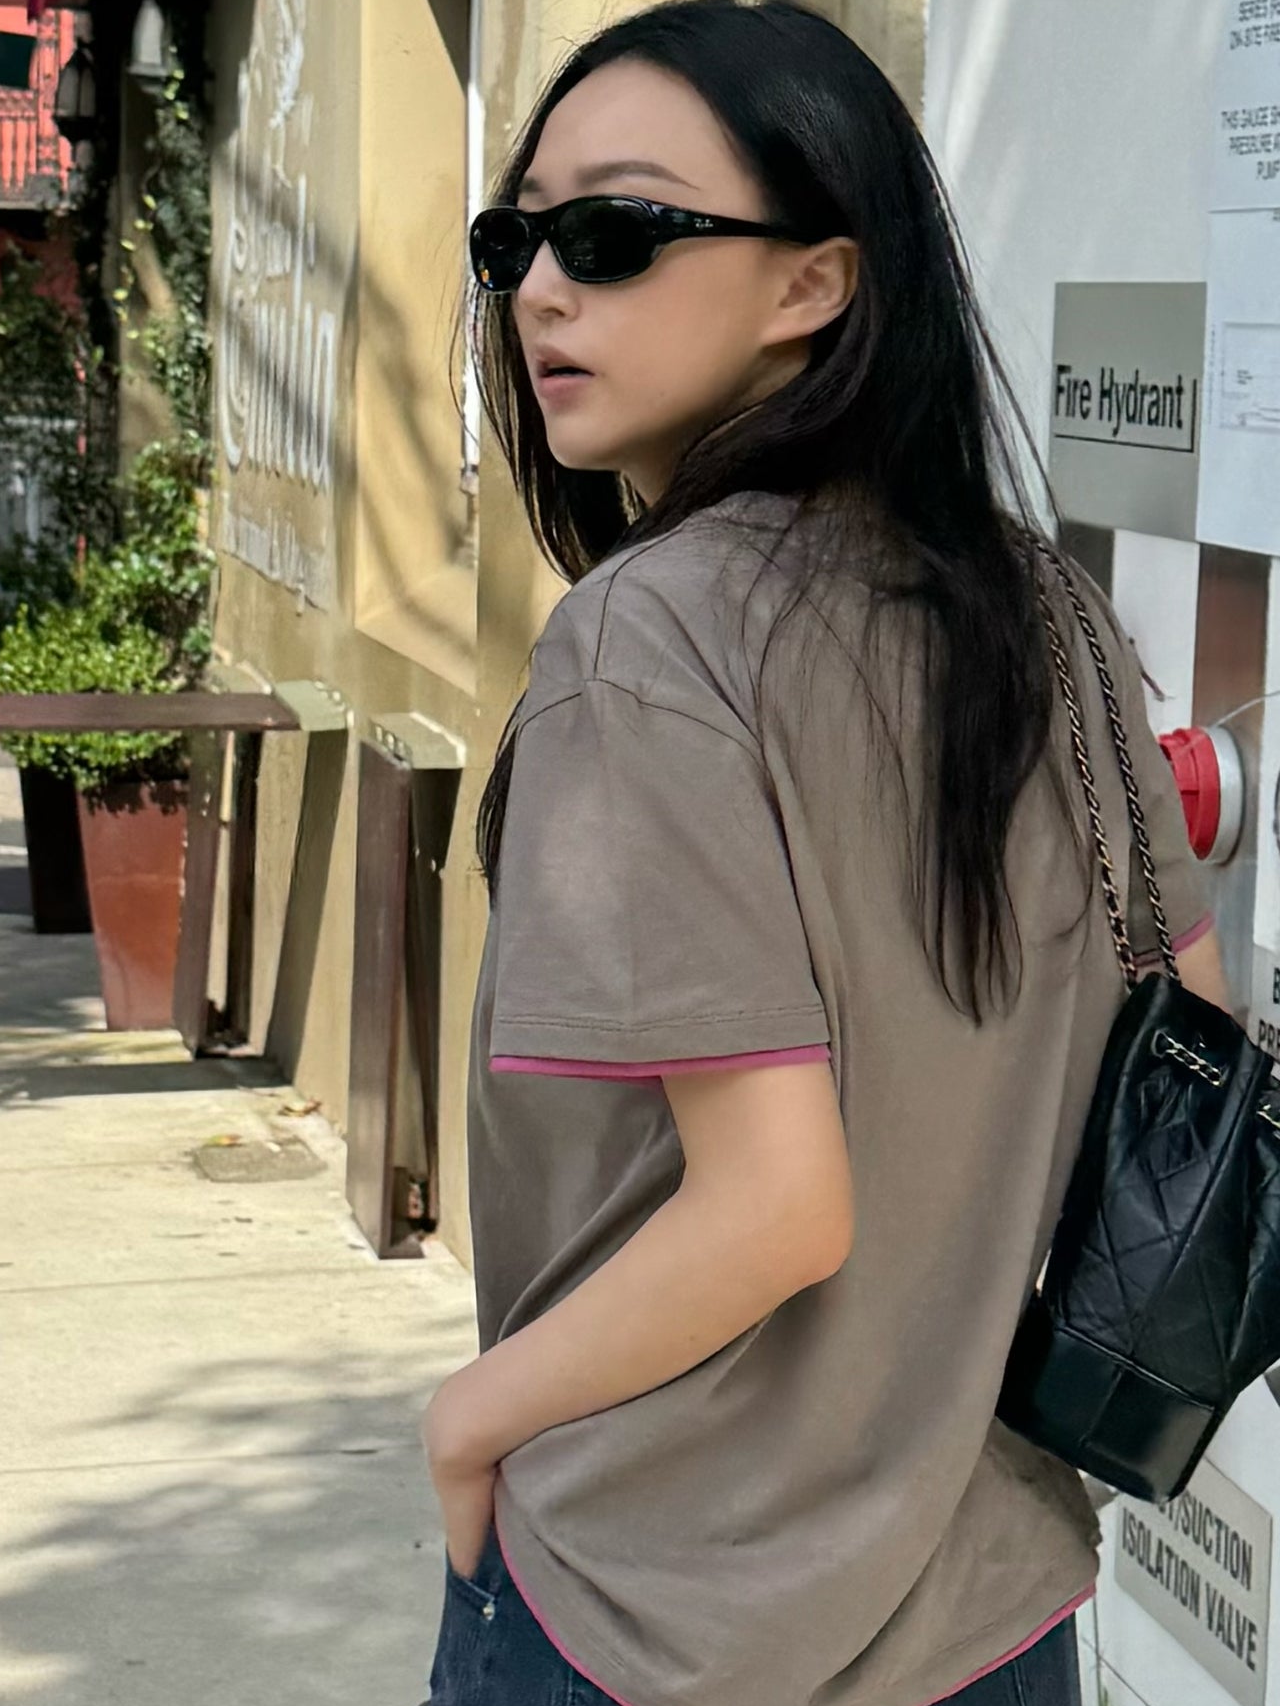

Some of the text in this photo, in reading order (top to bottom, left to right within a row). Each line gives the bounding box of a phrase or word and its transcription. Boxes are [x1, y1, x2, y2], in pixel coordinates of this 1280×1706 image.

[1221, 109, 1238, 133] THIS
[1054, 363, 1092, 421] Fire
[1098, 366, 1184, 437] Hydrant
[1121, 1506, 1258, 1673] ISOLATION VALVE
